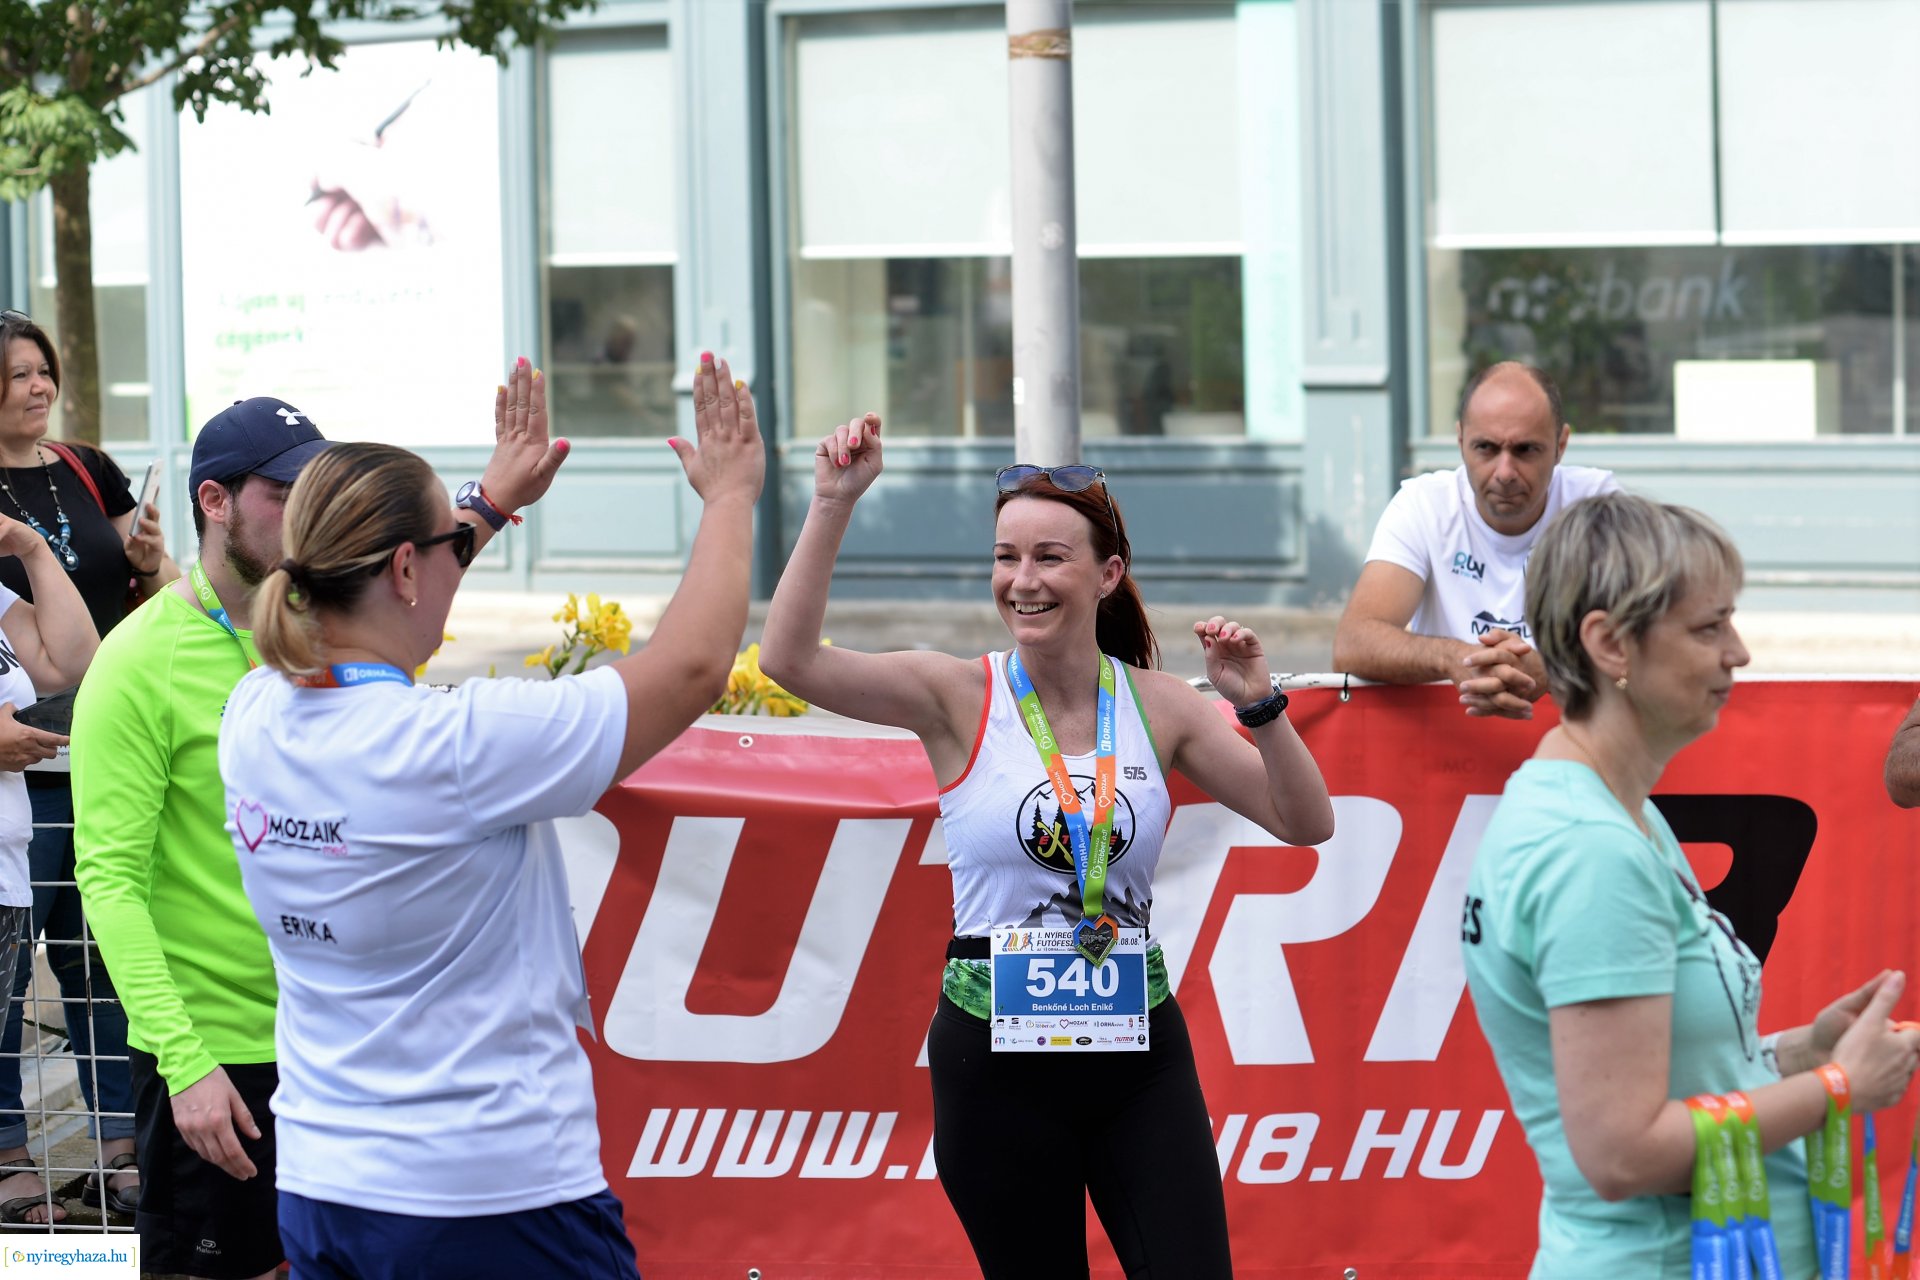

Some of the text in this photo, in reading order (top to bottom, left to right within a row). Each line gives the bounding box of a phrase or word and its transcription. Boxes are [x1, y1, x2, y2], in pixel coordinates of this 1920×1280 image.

[268, 813, 343, 843] MOZAIK
[280, 914, 337, 944] ERIKA
[1044, 930, 1073, 939] NYÍREG
[1025, 957, 1120, 998] 540
[1032, 1002, 1114, 1011] Benkőné Loch Enikő
